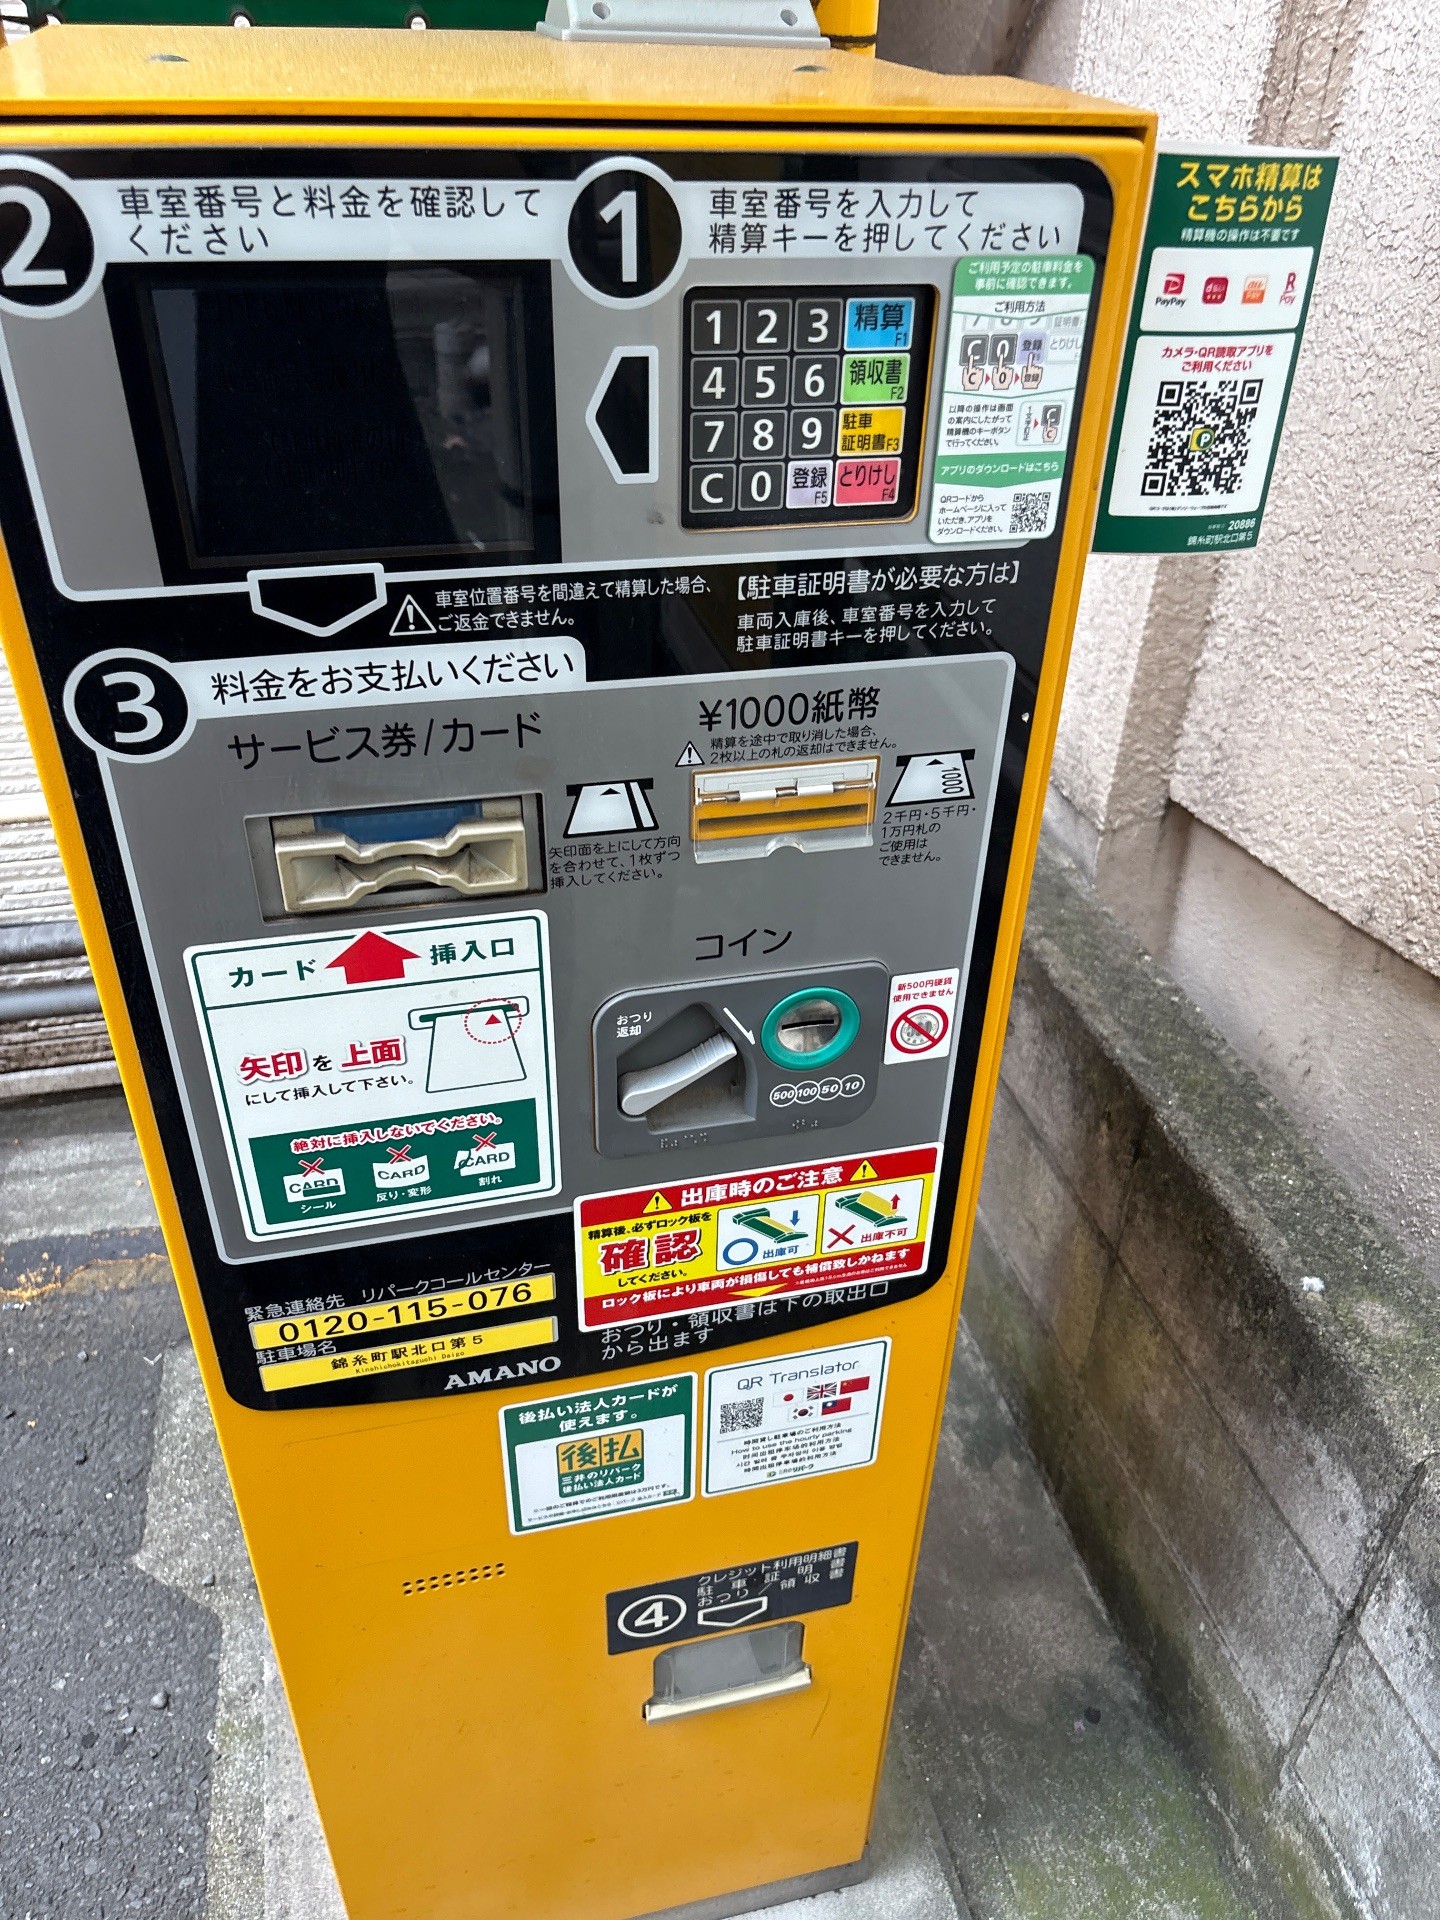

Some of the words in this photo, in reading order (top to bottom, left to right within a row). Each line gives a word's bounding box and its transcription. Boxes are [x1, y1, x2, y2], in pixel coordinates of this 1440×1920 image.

[1176, 162, 1323, 192] スマホ精算は
[118, 184, 541, 221] 車室番号と料金を確認して
[709, 188, 981, 220] 車室番号を入力して
[1187, 193, 1303, 223] こちらから
[0, 184, 68, 287] 2
[127, 223, 270, 256] ください
[599, 189, 638, 284] 1
[708, 221, 1061, 254] 精算キーを押してください
[1181, 227, 1300, 243] 精算機の操作は不要です
[994, 300, 1046, 314] ご利用方法
[1155, 297, 1186, 308] PayPay
[705, 309, 722, 345] 1
[756, 308, 779, 344] 2
[807, 308, 830, 344] 3
[853, 303, 906, 332] 精算
[894, 332, 909, 348] F1
[850, 359, 903, 386] 領収書
[1181, 360, 1253, 373] ご利用ください
[702, 366, 726, 400] 4
[755, 365, 776, 399] 5
[804, 364, 826, 398] 6
[890, 386, 905, 400] F2
[947, 414, 1012, 425] の案内にしたがって
[948, 402, 1014, 414] 以降の操作は画面
[704, 420, 725, 453] 7
[752, 419, 775, 451] 8
[801, 417, 823, 451] 9
[842, 413, 873, 431] 駐車
[841, 434, 887, 452] 証明書
[886, 437, 900, 452] F3
[945, 437, 1000, 448] で行ってください。
[792, 466, 828, 490] 登録
[839, 466, 897, 487] とりけし
[940, 461, 1060, 476] アプリのダウンロードはこちら
[700, 473, 724, 504] C
[751, 471, 773, 503] 0
[814, 490, 829, 505] F5
[881, 487, 896, 501] F4
[940, 494, 985, 504] QRコードから
[938, 503, 1007, 515] ホームページに入って
[937, 526, 1004, 536] ダウンロードください。
[435, 574, 712, 608] 車室位置番号を間違えて精算した場合、
[736, 560, 1020, 602] 【駐車証明書が必要な方は】
[438, 608, 576, 633] ご返金できません。
[736, 598, 997, 632] 車両入庫後、車室番号を入力して
[736, 621, 994, 653] 駐車証明書キーを押してください。
[211, 650, 575, 705] 料金をお支払いください
[101, 671, 164, 744] 3
[699, 686, 881, 733] ¥1000紙幣
[228, 710, 544, 771] サービス券/カード
[710, 725, 879, 750] 精算を途中で取り消した場合、
[710, 738, 898, 766] 2枚以上の札の返却はできません。
[941, 767, 965, 795] 1000
[881, 822, 942, 841] 1万円札の
[550, 834, 681, 860] 矢印面を上にして方向
[878, 850, 942, 868] できません。
[879, 838, 928, 853] ご使用は
[550, 850, 681, 875] を合わせて、1枚ずつ
[550, 867, 664, 891] 挿入してください。
[695, 928, 793, 962] コイン
[228, 959, 318, 990] カード
[429, 937, 516, 966] 挿入口
[893, 988, 954, 1003] 使用できません
[616, 1010, 653, 1026] おつり
[616, 1024, 643, 1039] 返却
[240, 1050, 303, 1082] 矢印
[312, 1054, 333, 1073] を
[341, 1037, 403, 1069] 上面
[245, 1074, 415, 1107] にして挿入して下さい。
[773, 1088, 796, 1101] 500
[797, 1085, 820, 1099] 100
[820, 1082, 840, 1096] 50
[844, 1079, 861, 1093] 10
[291, 1112, 503, 1154] 絶対に挿入しないでください。
[377, 1164, 427, 1181] CARD
[458, 1150, 511, 1169] CARD
[376, 1185, 434, 1203] 反り・変形
[478, 1175, 503, 1188] 割れ
[680, 1165, 845, 1208] 出庫時のご注意
[300, 1201, 338, 1214] シール
[588, 1210, 712, 1241] 精算後、必ずロック板を
[860, 1226, 909, 1244] 出庫不可
[599, 1228, 703, 1275] 確認
[762, 1244, 801, 1260] 出庫可
[601, 1247, 912, 1309] ロック板により車両が損傷しても補償致しかねます
[618, 1268, 690, 1288] してください。
[244, 1292, 345, 1323] 緊急連絡先
[361, 1262, 551, 1303] リパークコールセンター
[278, 1281, 533, 1343] 0120-115-076
[601, 1280, 890, 1345] おつり・領収書は下の取出口
[256, 1339, 337, 1366] 駐車場名
[601, 1328, 714, 1361] から出ます
[444, 1355, 562, 1391] AMANO
[737, 1376, 764, 1393] QR
[769, 1360, 860, 1385] Translator
[518, 1383, 679, 1425] 後払い法人カードが
[559, 1409, 638, 1433] 使えます。
[561, 1434, 641, 1471] 後払
[731, 1447, 750, 1455] How
[779, 1438, 793, 1446] the
[794, 1433, 820, 1444] hourly
[821, 1427, 853, 1439] parking
[561, 1462, 642, 1485] 三井のリパーク
[562, 1472, 642, 1494] 後払い法人カード
[698, 1547, 848, 1587] クレジット利用明細書
[633, 1600, 670, 1629] 4
